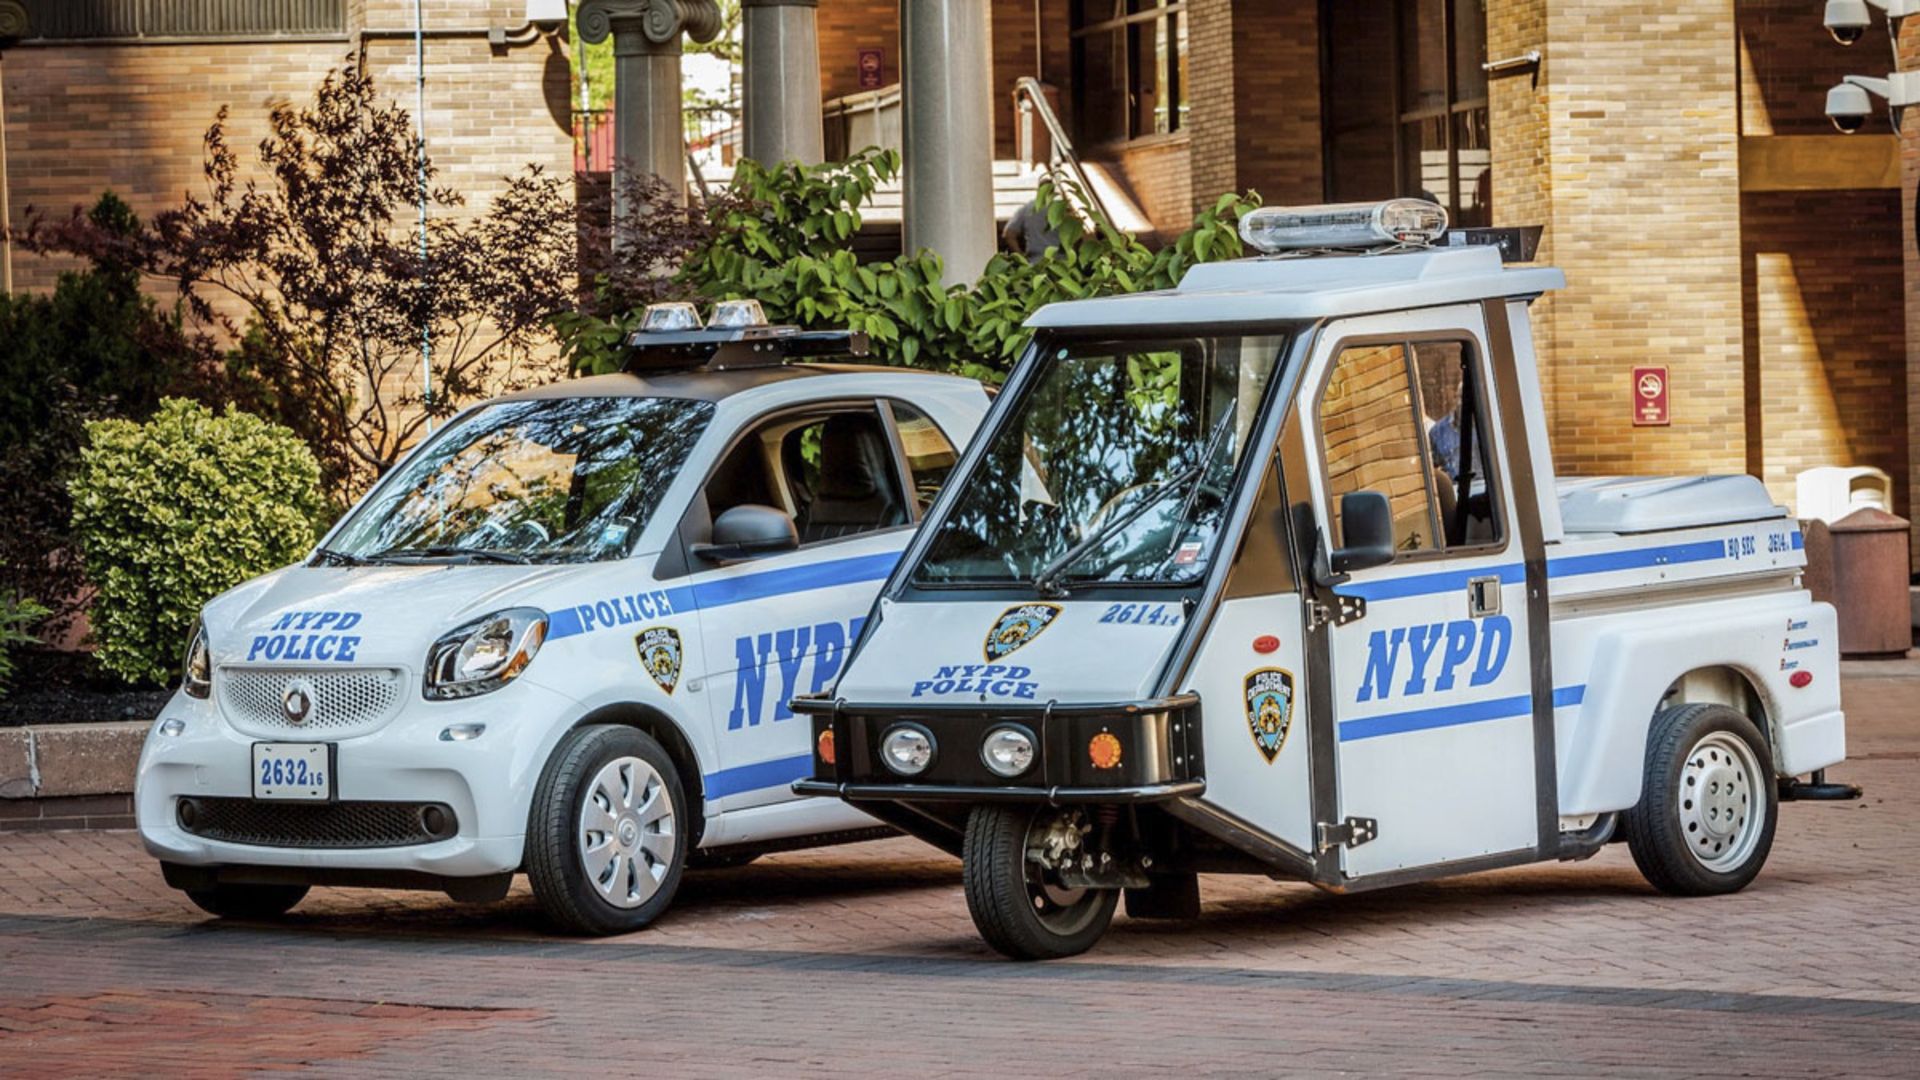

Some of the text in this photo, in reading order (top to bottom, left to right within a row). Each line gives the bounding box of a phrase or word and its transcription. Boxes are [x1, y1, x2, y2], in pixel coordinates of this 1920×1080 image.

[271, 611, 362, 631] NYPD
[577, 589, 672, 633] POLICE
[1098, 603, 1166, 624] 2614
[246, 634, 361, 662] POLICE
[1356, 615, 1512, 703] NYPD
[728, 616, 869, 731] NYP
[933, 665, 1031, 680] NYPD
[1256, 671, 1281, 683] POLICE
[911, 679, 1039, 699] POLICE
[261, 758, 324, 786] 2632 16
